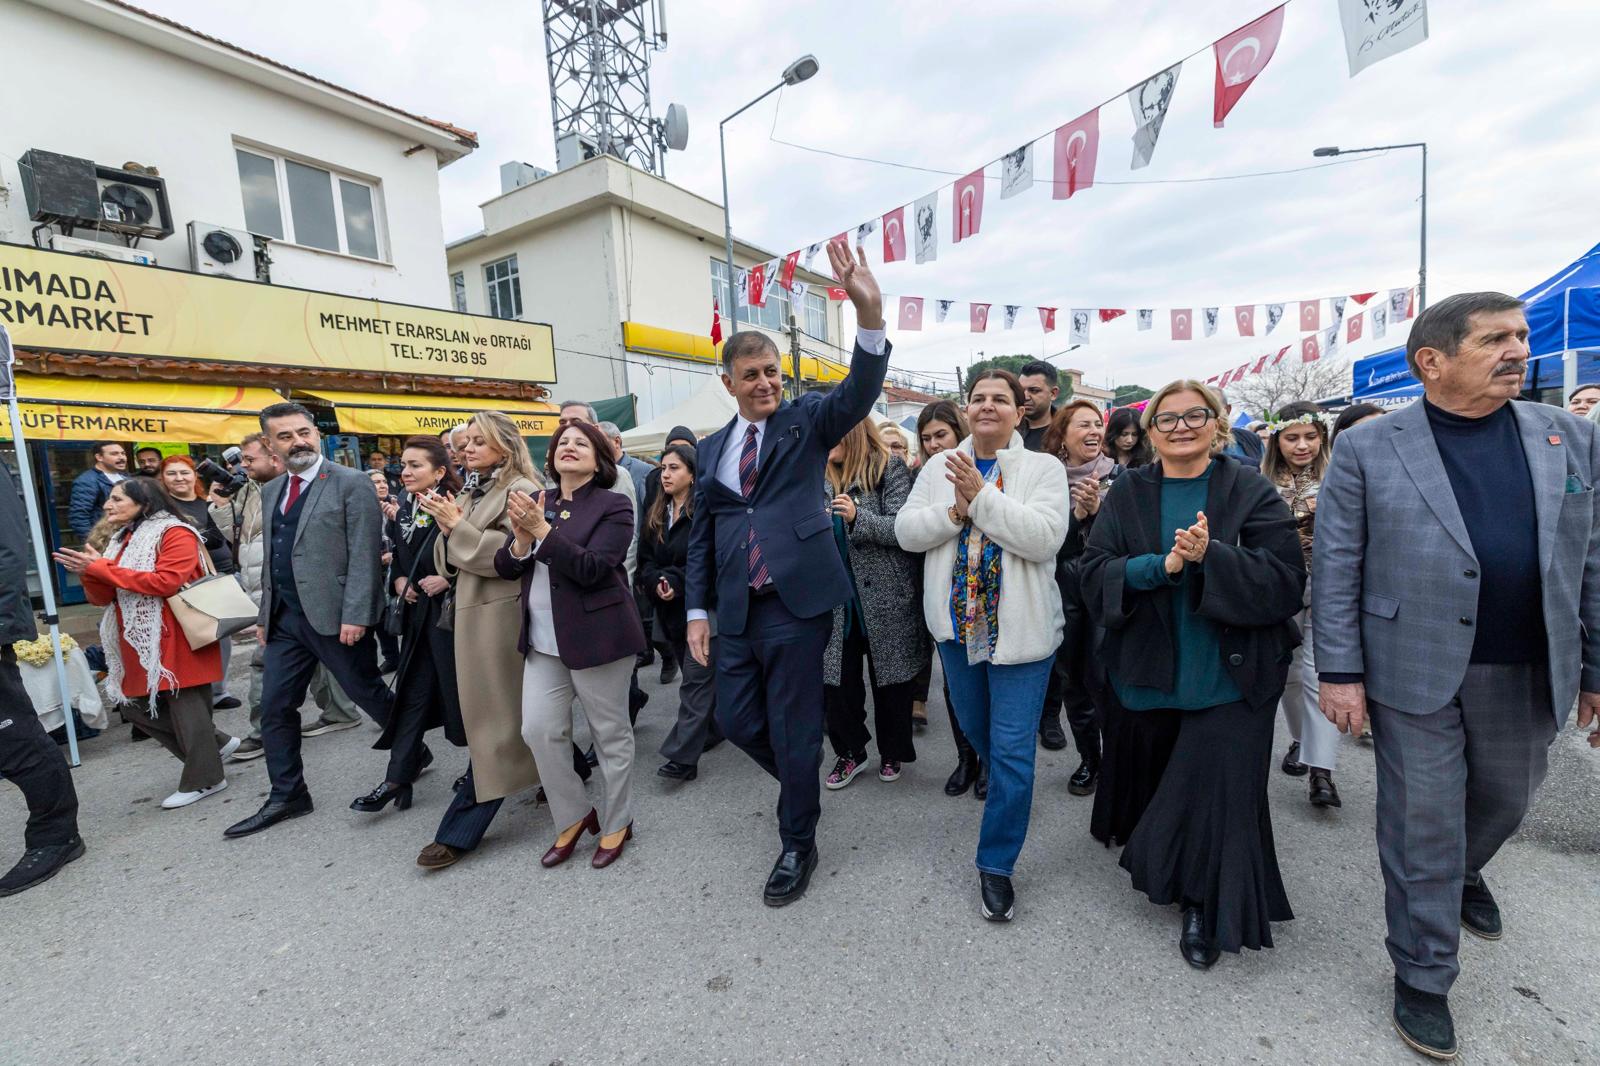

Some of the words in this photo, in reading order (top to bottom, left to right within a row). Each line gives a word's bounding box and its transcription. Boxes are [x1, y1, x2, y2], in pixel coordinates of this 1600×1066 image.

[0, 266, 116, 303] IMADA
[320, 312, 391, 335] MEHMET
[396, 322, 470, 345] ERARSLAN
[473, 335, 488, 346] ve
[490, 334, 532, 351] ORTAĞI
[390, 343, 423, 360] TEL:
[425, 346, 448, 362] 731
[451, 350, 468, 364] 36
[470, 352, 487, 366] 95
[9, 409, 168, 433] ÜPERMARKET
[415, 416, 469, 429] YARIMAD
